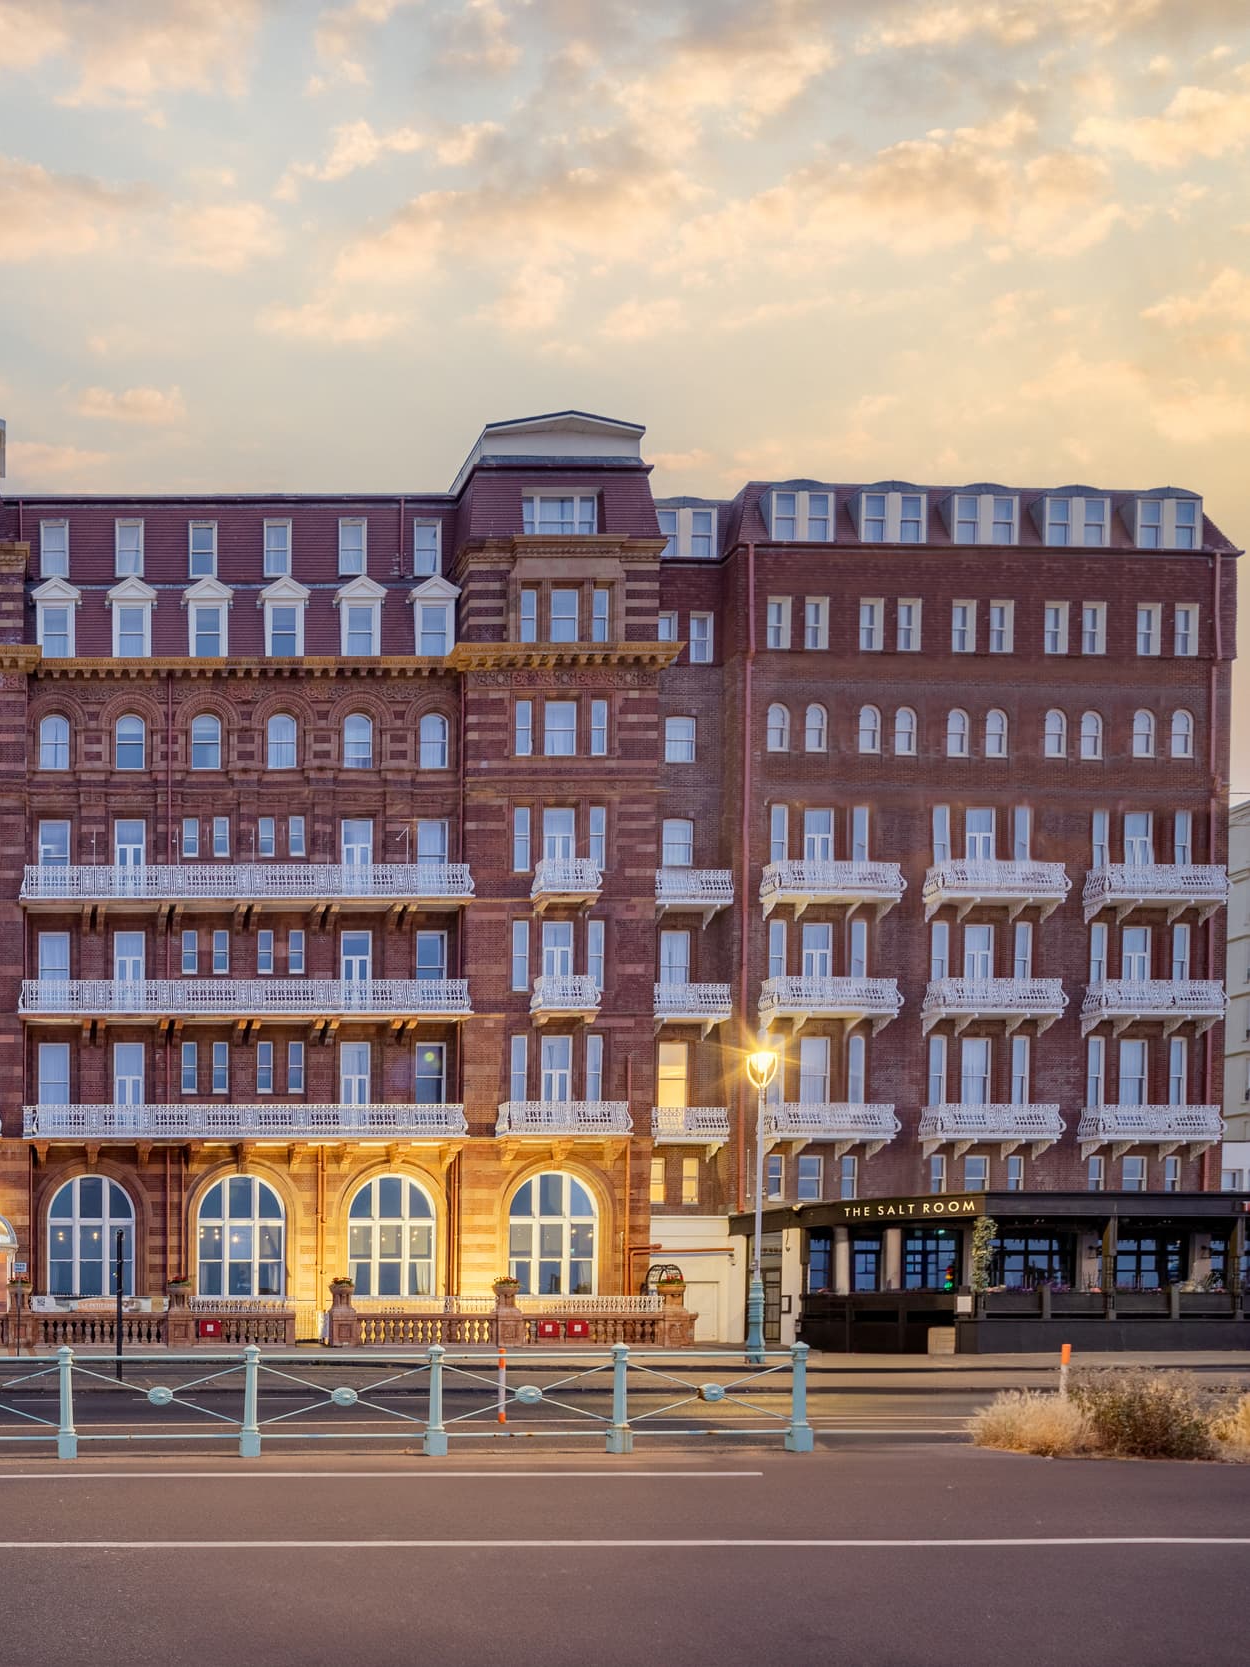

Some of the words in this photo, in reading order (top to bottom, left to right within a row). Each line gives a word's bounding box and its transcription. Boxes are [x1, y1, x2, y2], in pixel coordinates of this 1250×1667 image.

[844, 1207, 871, 1217] THE
[877, 1204, 915, 1216] SALT
[922, 1200, 975, 1214] ROOM
